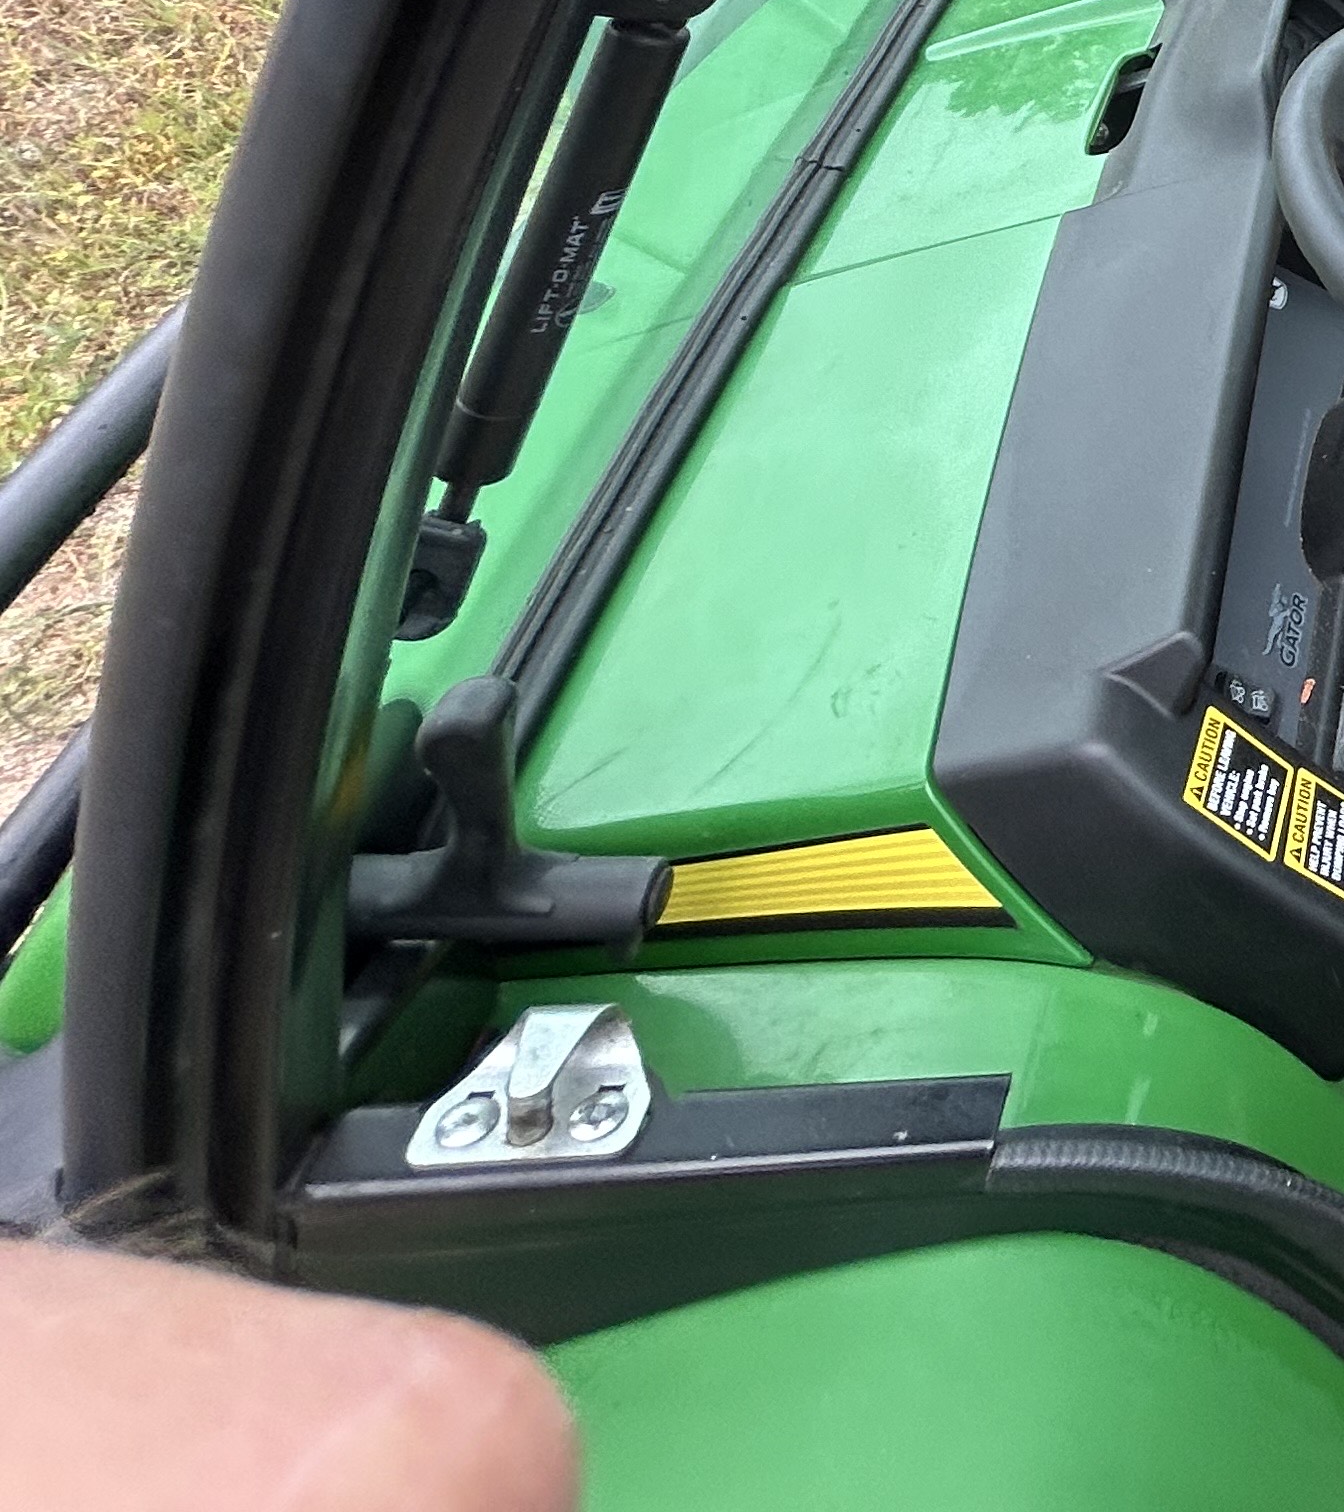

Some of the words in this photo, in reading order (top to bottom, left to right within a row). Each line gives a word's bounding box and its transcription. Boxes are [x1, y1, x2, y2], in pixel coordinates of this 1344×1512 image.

[1280, 592, 1309, 668] GATOR
[1194, 717, 1221, 782] CAUTION
[1291, 777, 1313, 843] CAUTION
[1312, 799, 1328, 846] PREVENT
[1308, 845, 1320, 873] HELP
